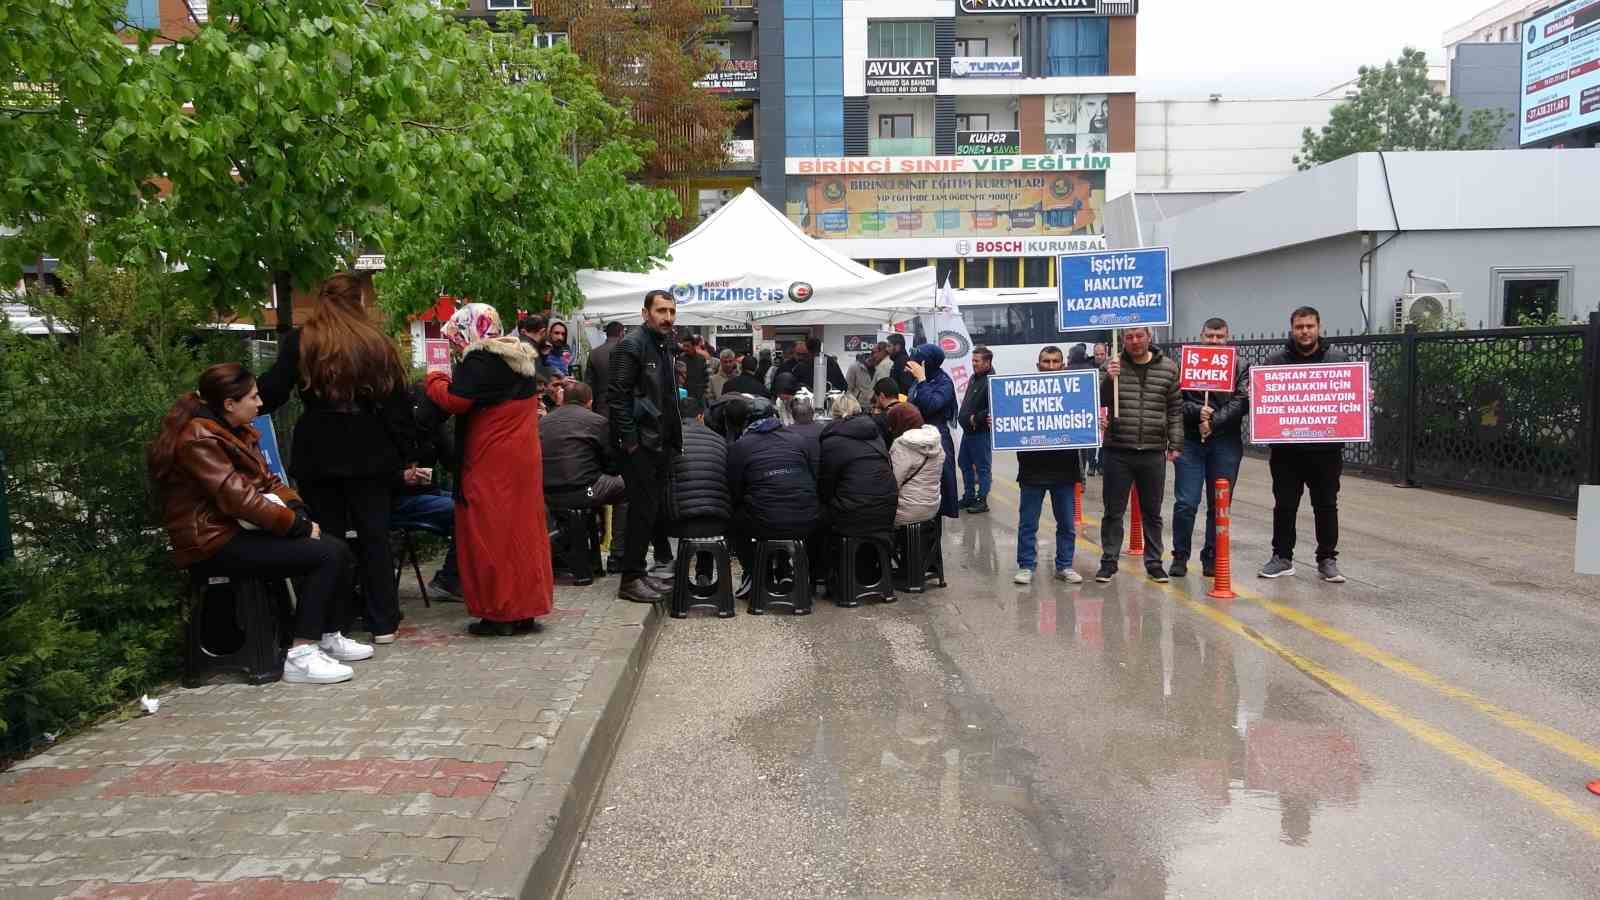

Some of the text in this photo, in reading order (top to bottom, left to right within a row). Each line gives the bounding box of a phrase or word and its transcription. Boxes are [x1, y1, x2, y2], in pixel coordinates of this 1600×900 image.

[867, 61, 934, 76] AVUKAT
[798, 154, 1111, 173] BİRİNCİ SINIF VİP EĞİTİM
[976, 240, 1106, 253] BOSCH KURUMSAL
[1090, 254, 1136, 274] İŞÇİYİZ
[1084, 276, 1144, 292] HAKLIYIZ
[1066, 292, 1161, 311] KAZANACAĞIZ!
[1187, 350, 1200, 367] İŞ
[1211, 353, 1229, 368] AŞ
[1185, 368, 1228, 381] EKMEK
[1264, 369, 1352, 381] BAŞKAN ZEYDAN
[1004, 377, 1081, 396] MAZBATA VE
[1264, 379, 1352, 391] SEN HAKKIN İÇİN
[1022, 396, 1064, 413] EKMEK
[1261, 392, 1355, 403] SOKAKLARDAYDIN
[1256, 402, 1361, 414] BİZDE HAKKIMIZ İÇİN
[995, 409, 1094, 433] SENCE HANGİSİ?
[1279, 415, 1338, 425] BURADAYIZ
